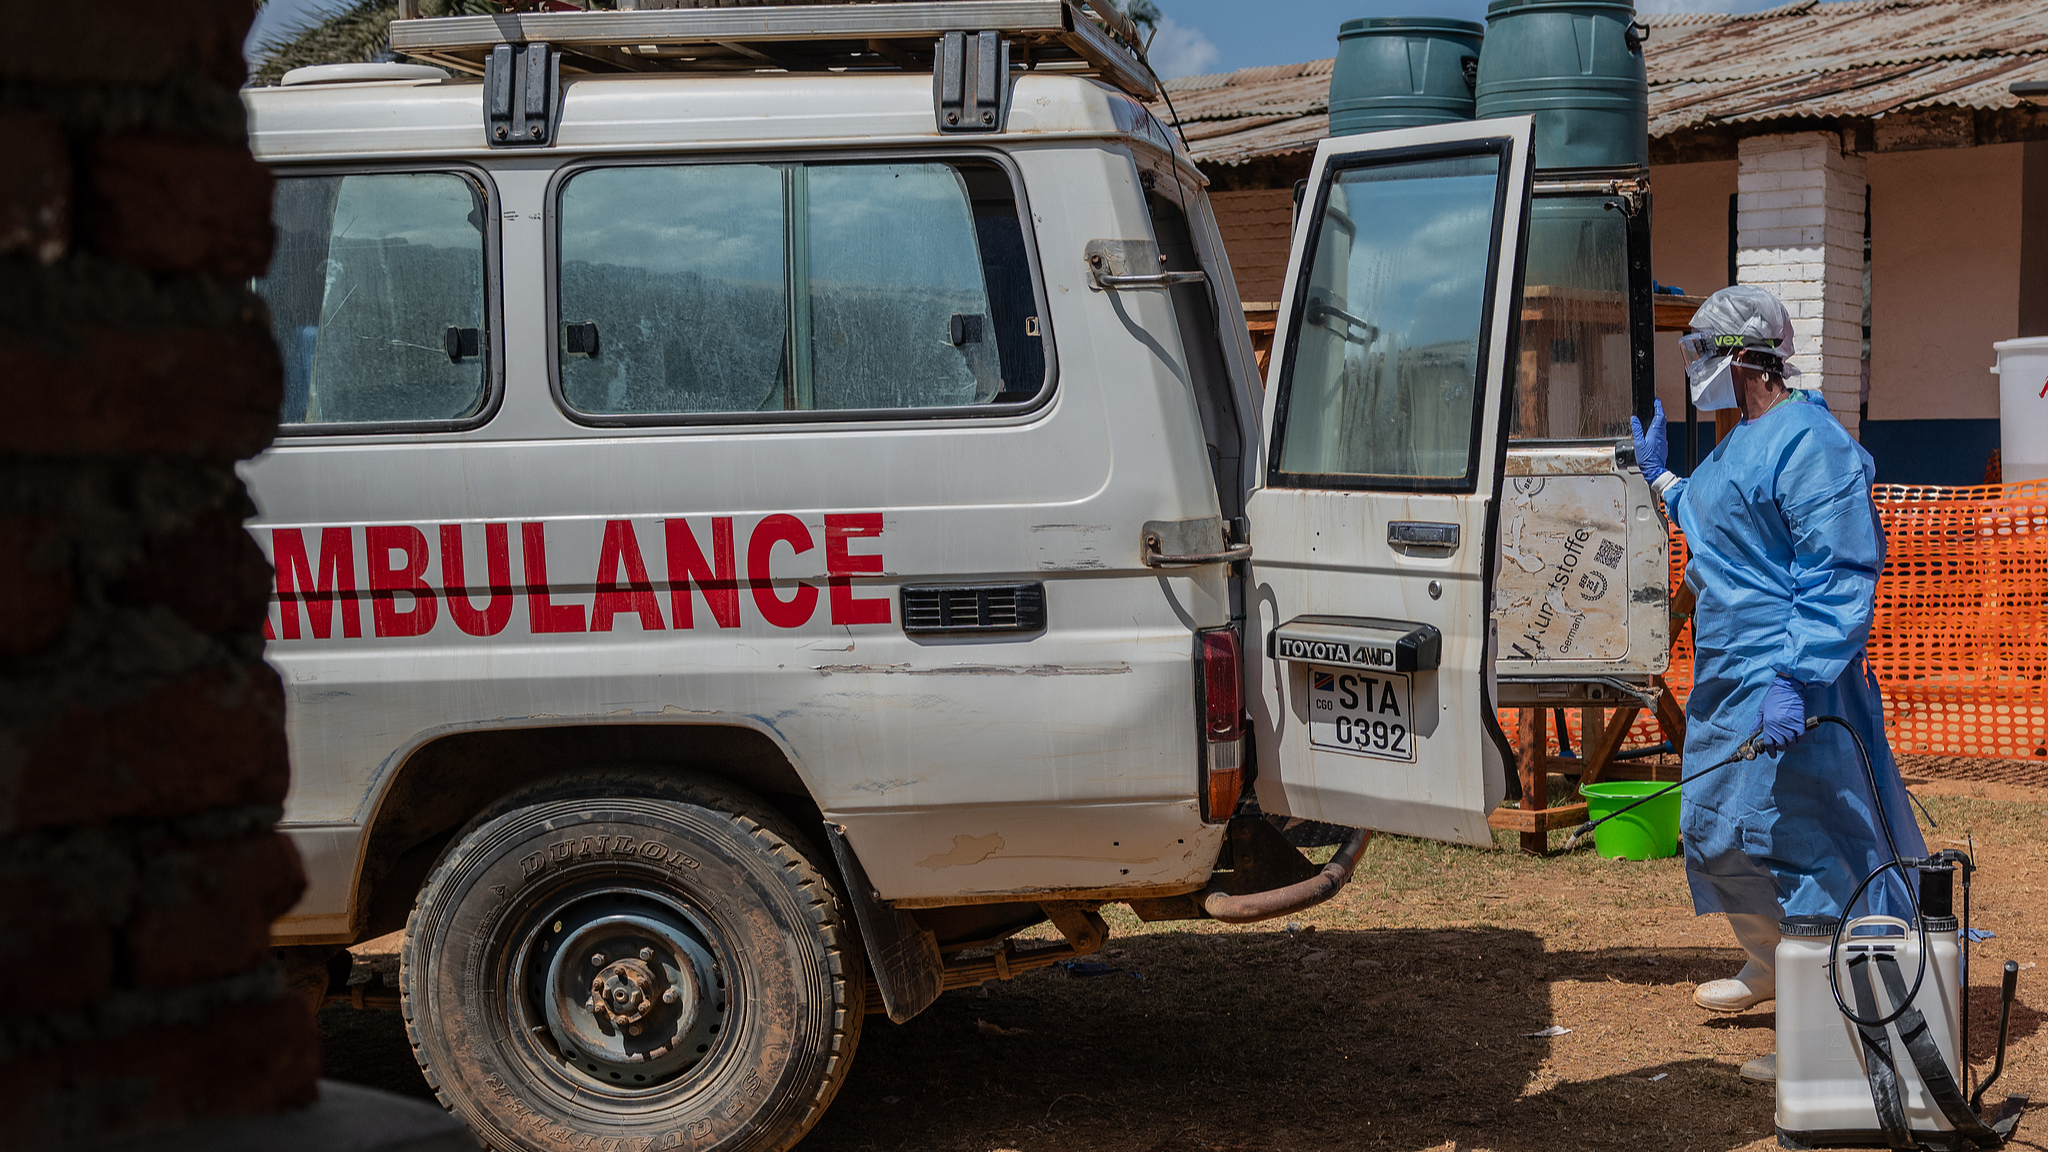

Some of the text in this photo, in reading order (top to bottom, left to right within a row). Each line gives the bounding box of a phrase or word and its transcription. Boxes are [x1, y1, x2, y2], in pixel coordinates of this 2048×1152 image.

[263, 512, 892, 640] MBULANCE
[1522, 528, 1590, 645] Kuntstoffe
[1578, 573, 1589, 589] BEN
[1282, 639, 1394, 667] TOYOTA 4WD
[1559, 612, 1586, 654] Germany
[1316, 698, 1333, 711] CGO
[1338, 674, 1401, 717] STA
[1335, 715, 1407, 753] 0392
[519, 835, 701, 880] DUNLOP
